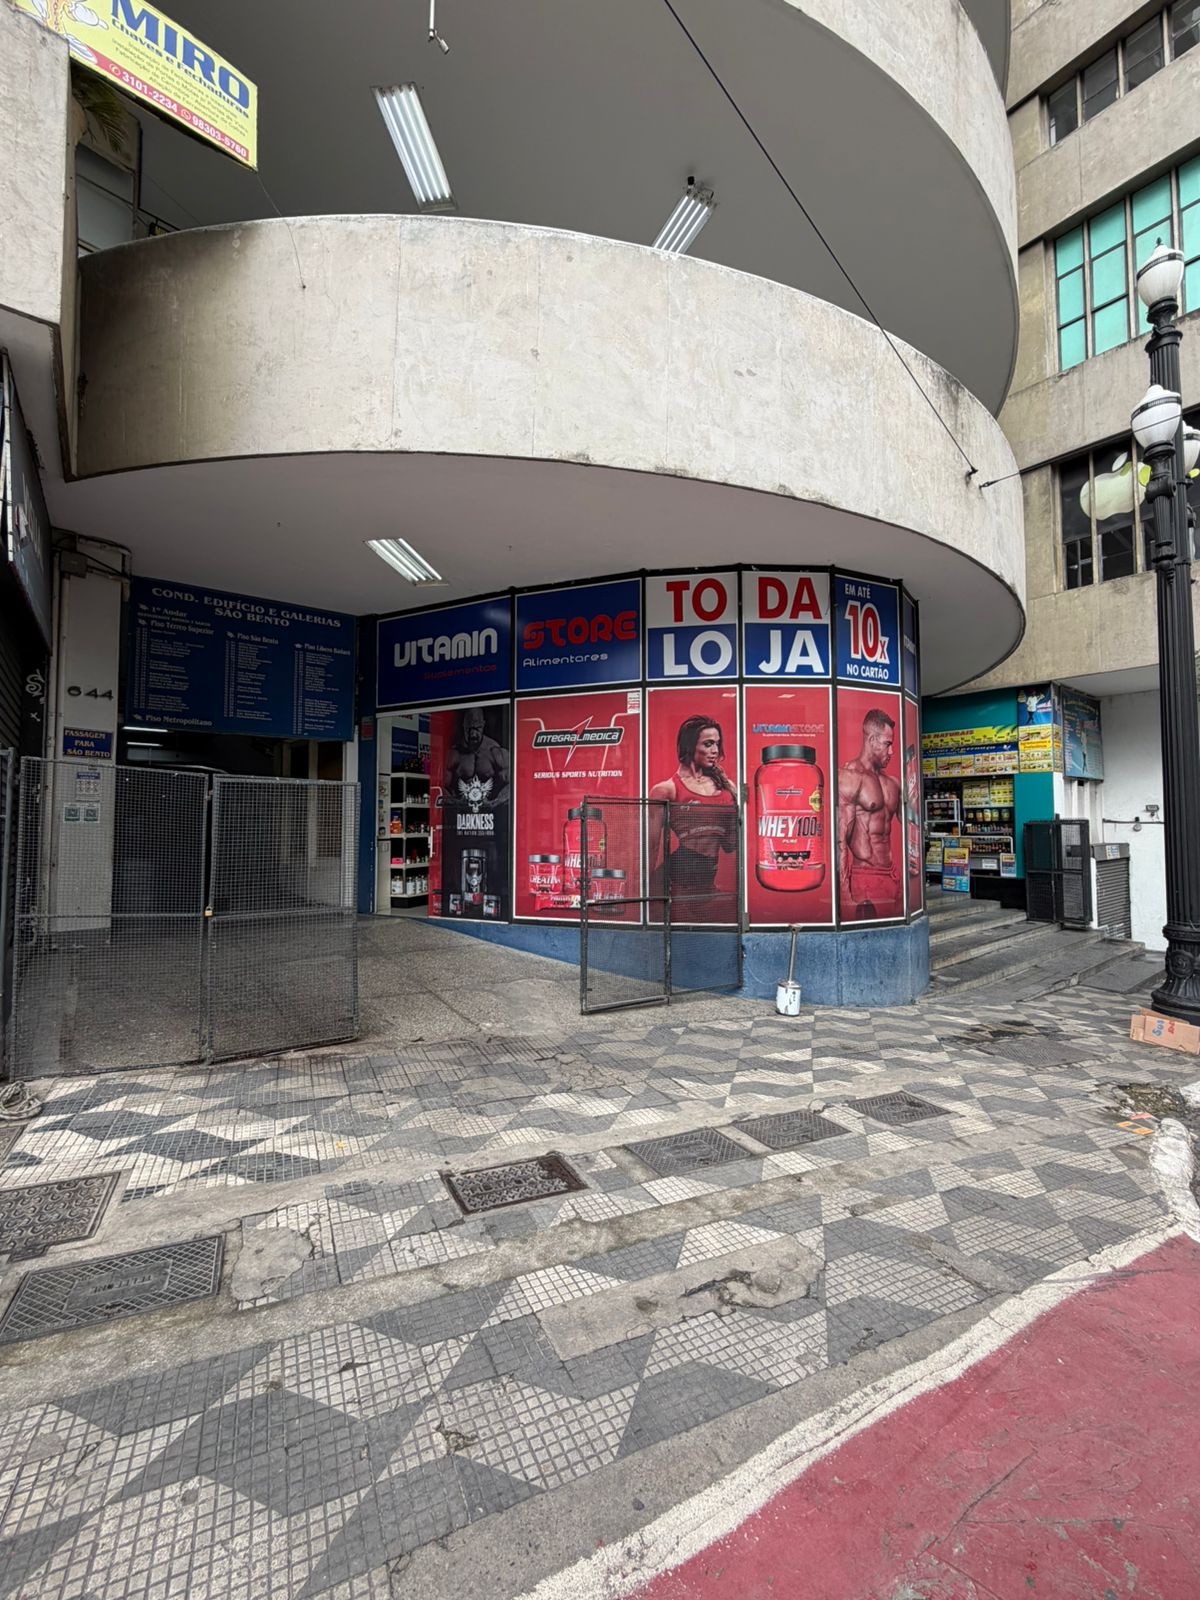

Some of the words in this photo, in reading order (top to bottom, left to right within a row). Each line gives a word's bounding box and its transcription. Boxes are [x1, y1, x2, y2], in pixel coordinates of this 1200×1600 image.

[112, 0, 250, 109] MIRO
[112, 18, 163, 57] Chaves
[166, 55, 175, 65] e
[177, 60, 250, 118] Fechaduras
[122, 71, 178, 113] 3101-2234
[844, 583, 856, 597] EM
[857, 583, 872, 599] ATÉ
[151, 587, 199, 603] COND.
[203, 595, 265, 615] EDIFÍCIO
[269, 608, 277, 616] E
[280, 610, 341, 628] GALERIAS
[666, 577, 727, 623] TO
[757, 576, 823, 620] DA
[162, 607, 188, 618] Andar
[215, 605, 244, 619] SÃO
[246, 613, 290, 628] BENTO
[150, 619, 165, 628] Piso
[188, 624, 215, 635] Superior
[393, 627, 498, 668] VITAMIN
[522, 610, 638, 651] STORE
[522, 652, 609, 668] Alimentares
[662, 630, 733, 677] LO
[758, 629, 825, 674] JA
[846, 664, 859, 677] NO
[860, 665, 889, 680] CARTÃO
[67, 685, 114, 701] 644
[145, 714, 162, 722] Piso
[163, 716, 213, 727] Metropolitano
[64, 729, 106, 740] PASSAGEM
[932, 729, 974, 739] NATURAIS
[74, 740, 96, 748] PARA
[66, 747, 83, 756] SÃO
[84, 749, 111, 758] BENTO
[533, 770, 560, 779] SERIOUS
[561, 770, 587, 779] SPORTS
[587, 770, 623, 778] NUTRITION
[456, 813, 495, 830] DARKNESS
[757, 815, 799, 838] WHEY
